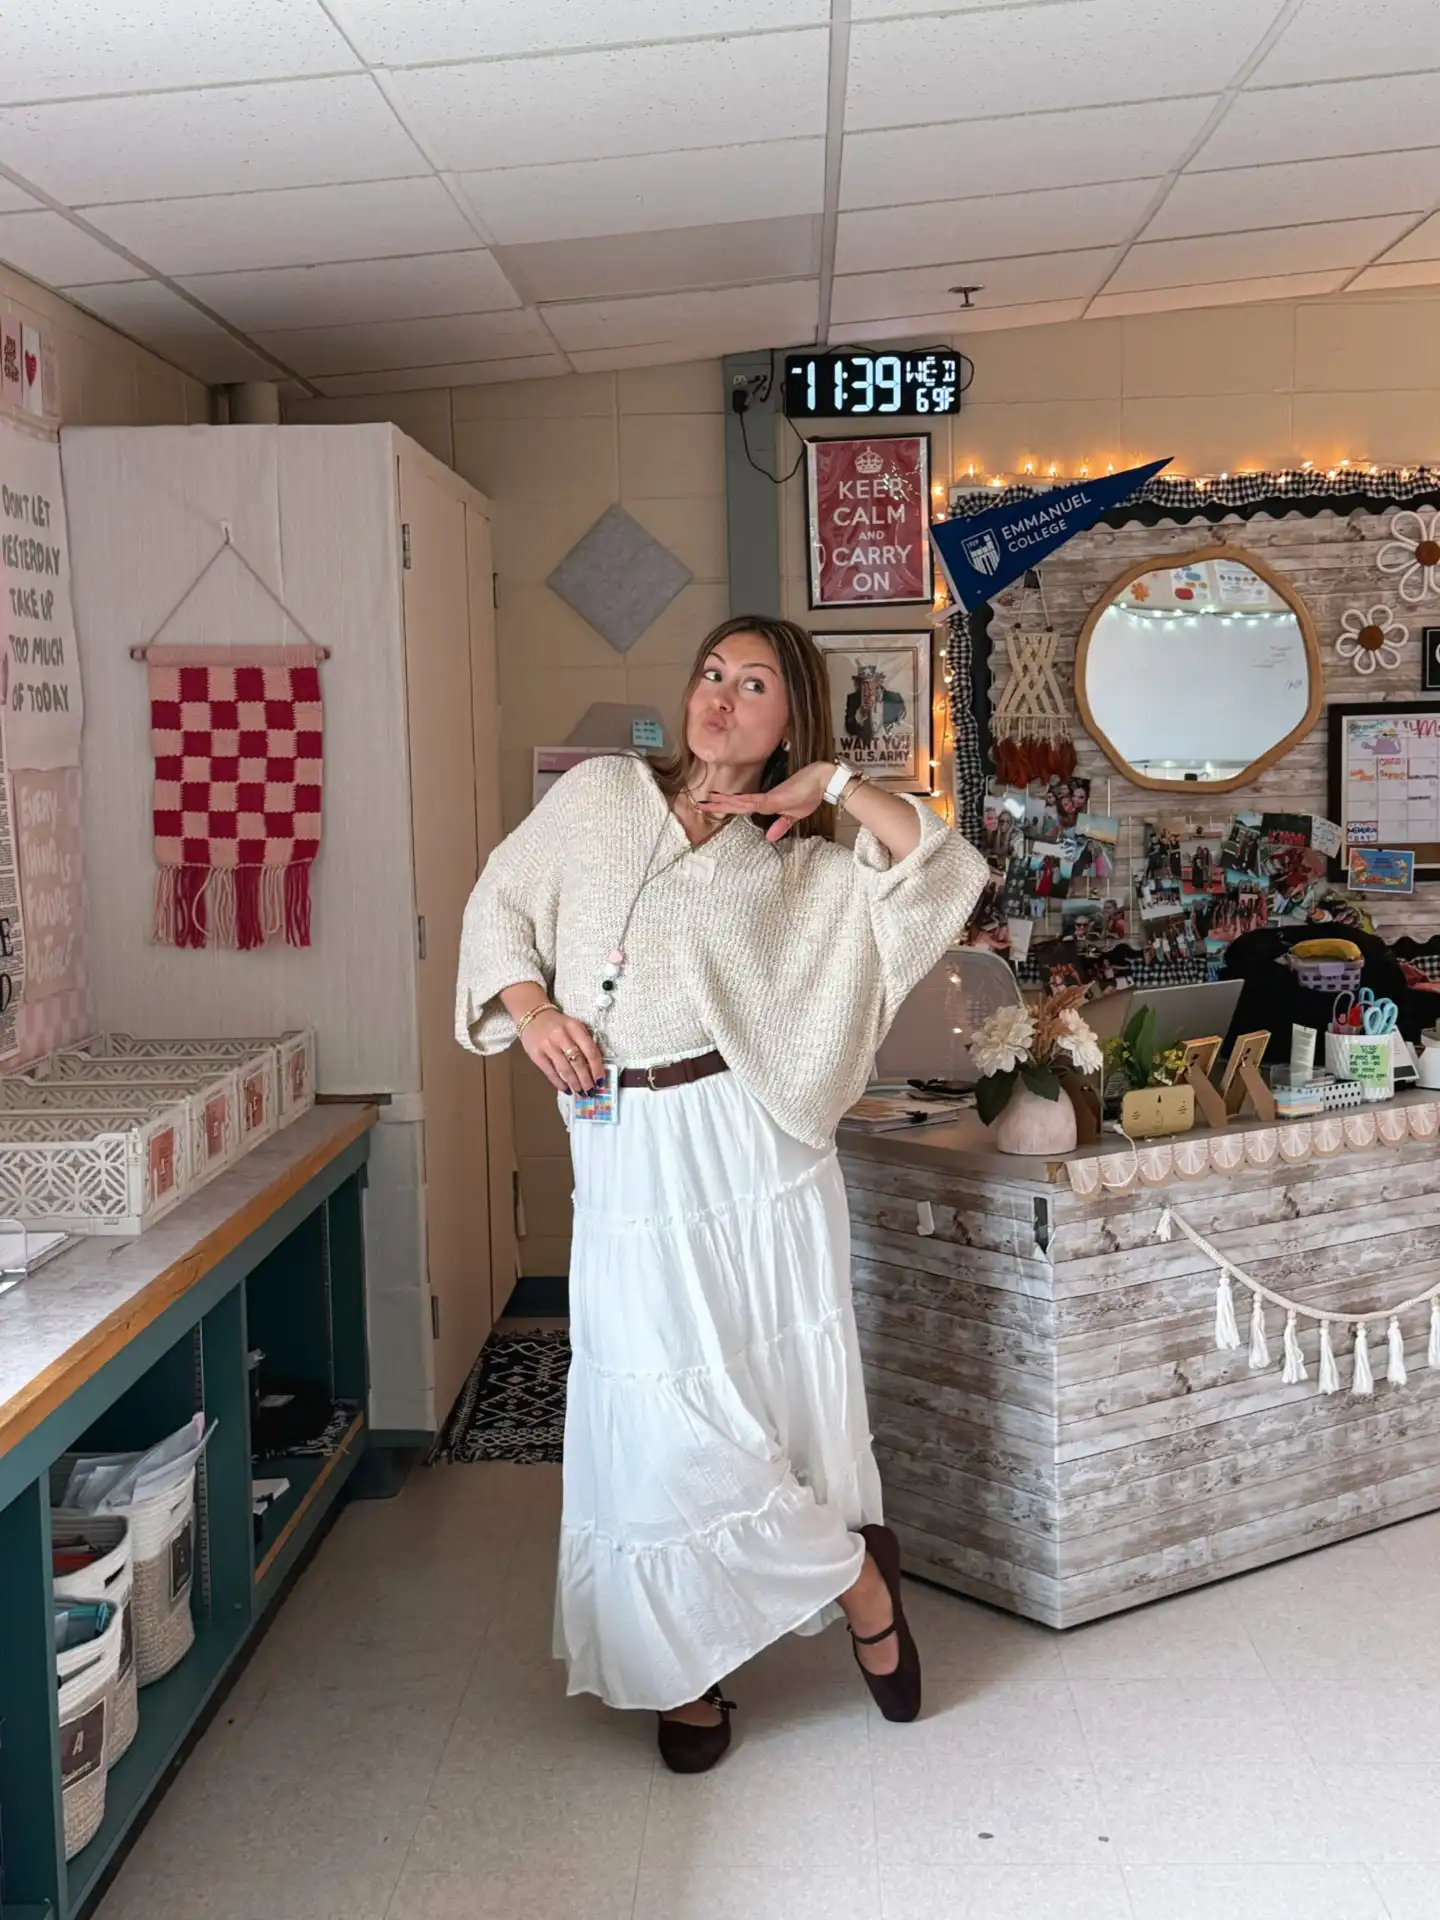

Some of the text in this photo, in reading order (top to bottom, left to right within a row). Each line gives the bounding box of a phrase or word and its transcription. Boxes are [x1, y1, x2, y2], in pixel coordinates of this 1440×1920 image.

[807, 356, 956, 413] 11:39 WED
[838, 478, 903, 500] KEEP
[32, 494, 51, 529] LET
[833, 503, 906, 526] CALM
[1001, 491, 1092, 540] EMMANUEL
[858, 530, 885, 541] AND
[1008, 519, 1068, 553] COLLEGE
[2, 533, 60, 576] YESTERDAY
[832, 544, 912, 567] CARRY
[852, 571, 891, 592] ON
[9, 587, 54, 621] TAKE UP
[9, 634, 64, 667] TOO MUCH
[12, 682, 69, 712] OF TODAY
[840, 737, 880, 751] WANT
[882, 734, 911, 750] YOU
[879, 751, 910, 762] ARMY
[72, 1730, 84, 1756] A
